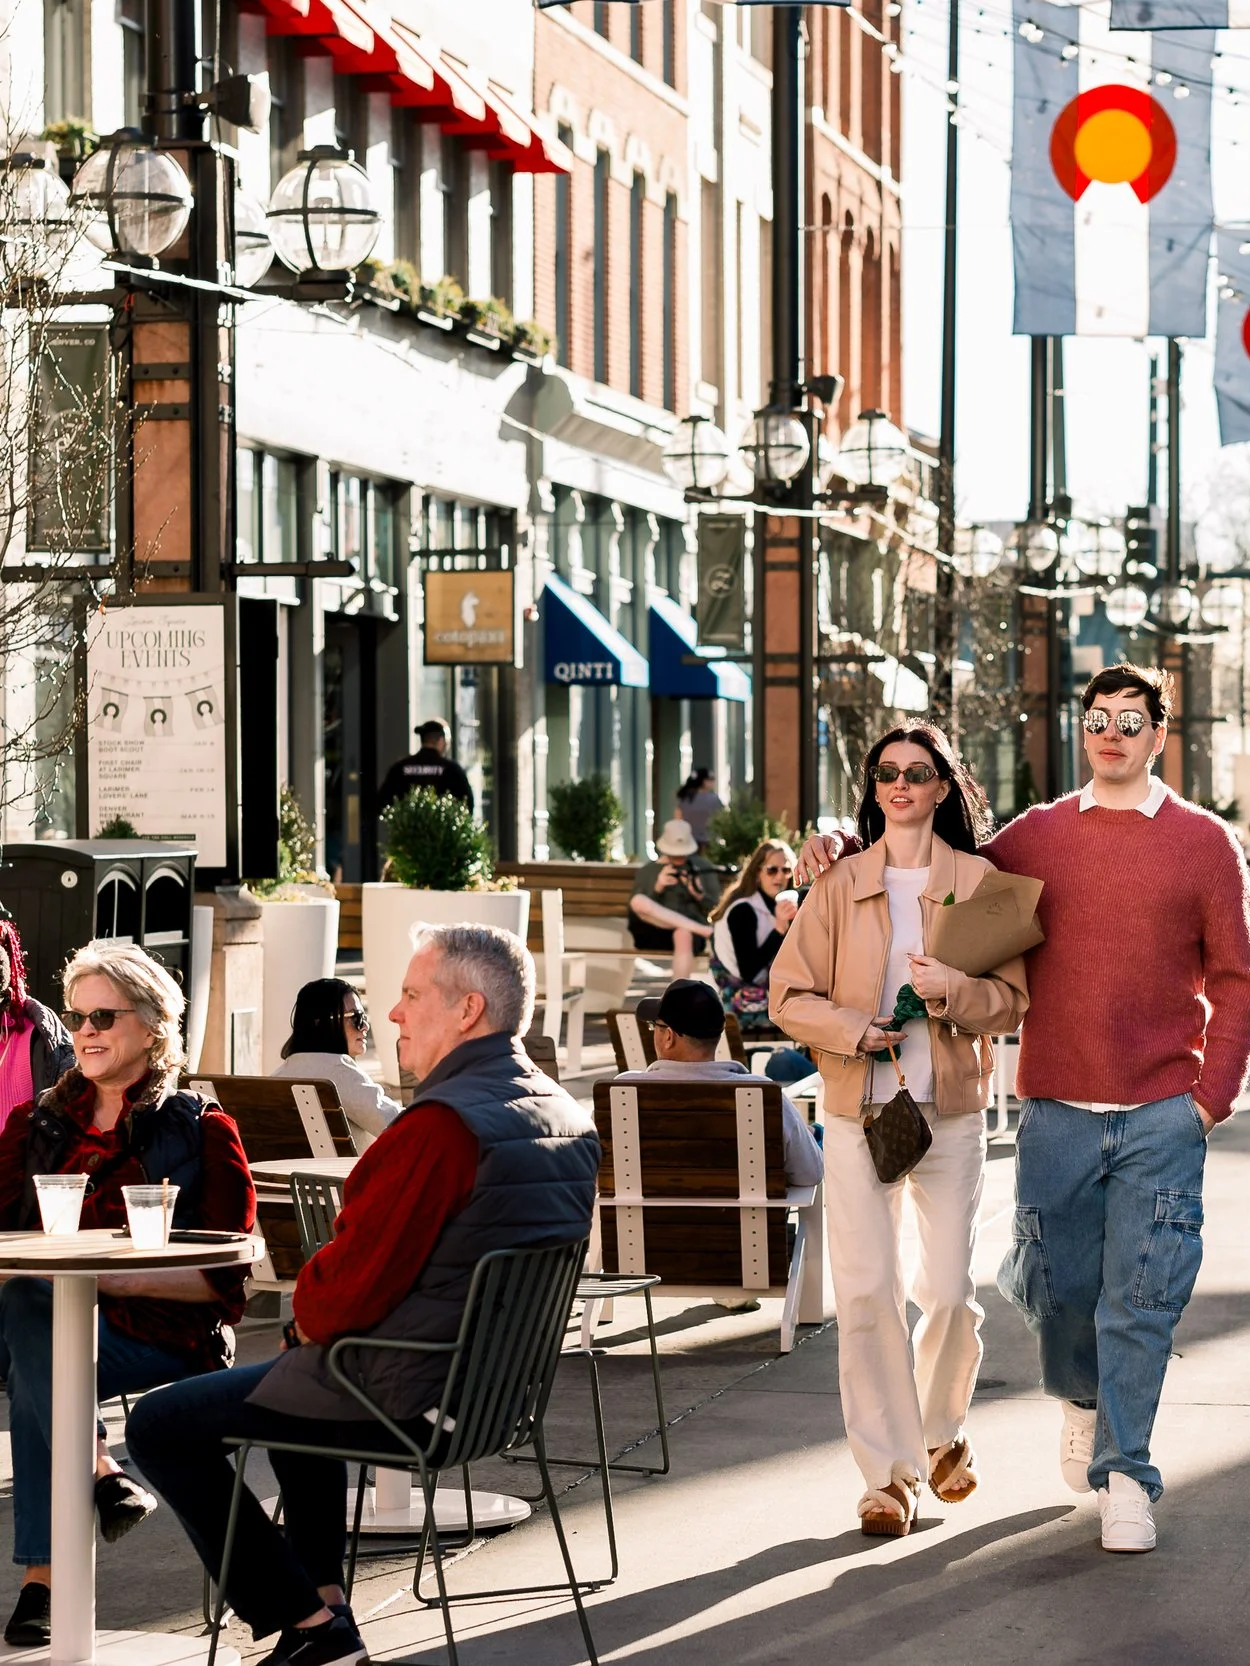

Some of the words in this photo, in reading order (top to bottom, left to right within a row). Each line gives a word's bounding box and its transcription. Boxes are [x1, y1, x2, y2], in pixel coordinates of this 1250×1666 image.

[107, 630, 206, 649] UPCOMING
[121, 649, 191, 668] EVENTS
[553, 662, 613, 682] QINTI
